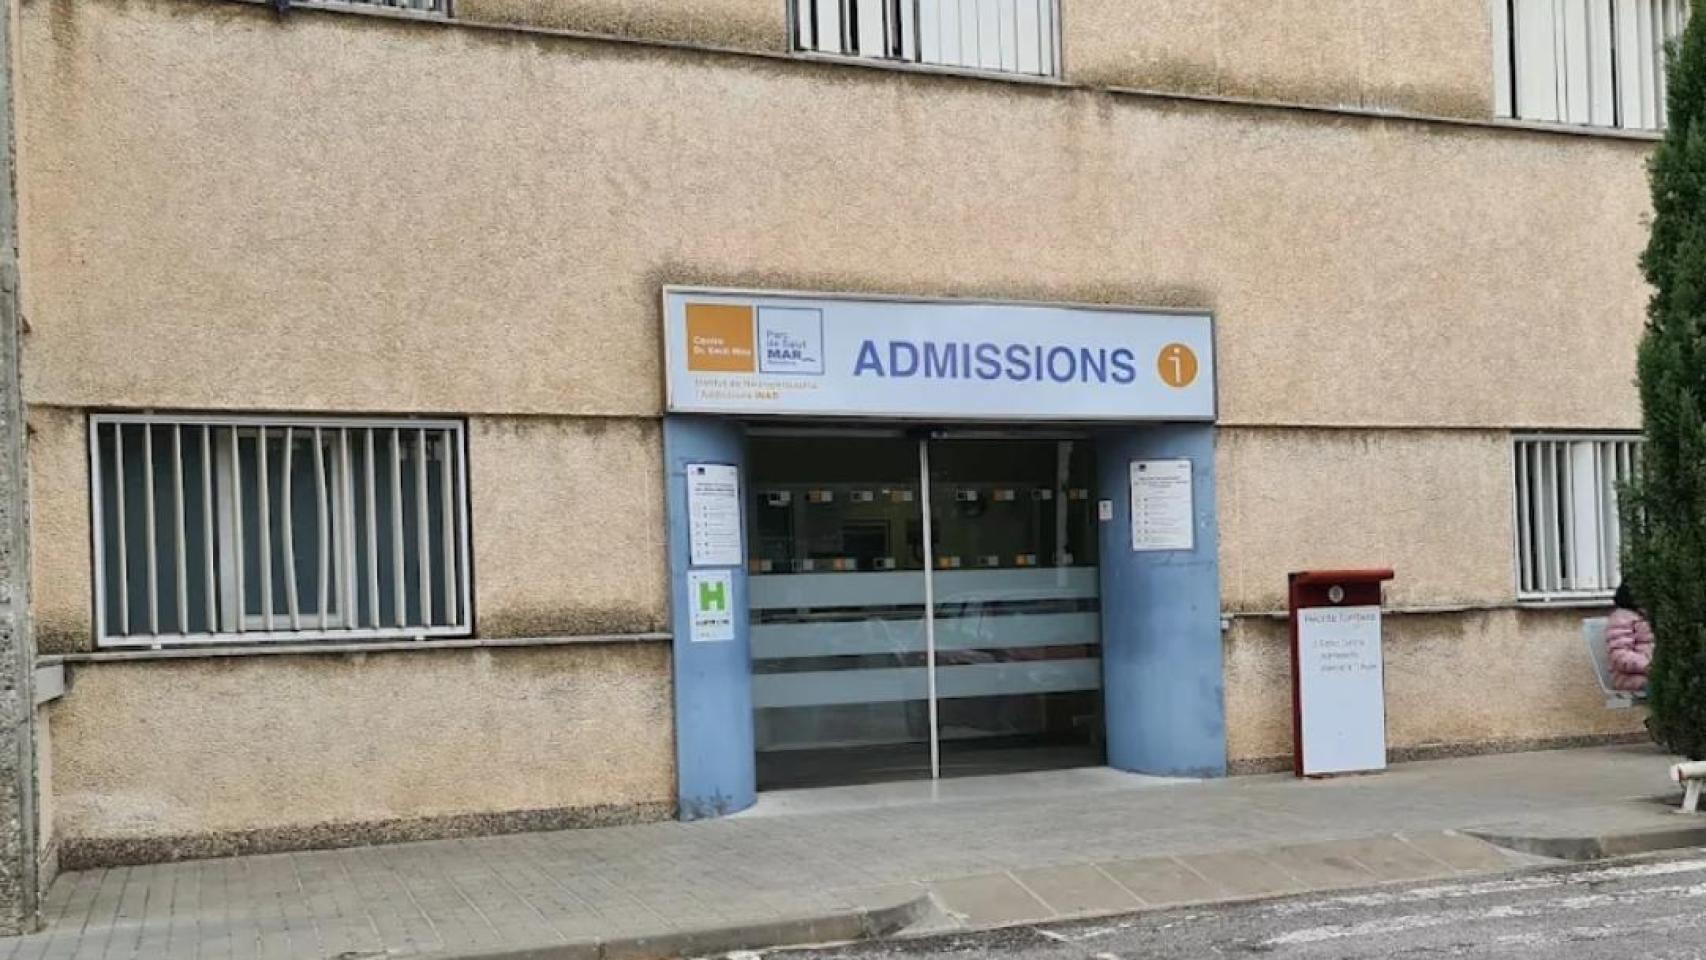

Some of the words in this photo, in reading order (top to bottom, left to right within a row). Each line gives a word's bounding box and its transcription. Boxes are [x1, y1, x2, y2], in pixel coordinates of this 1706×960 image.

[767, 349, 802, 360] MAR
[853, 340, 1136, 384] ADMISSIONS
[700, 581, 724, 611] H
